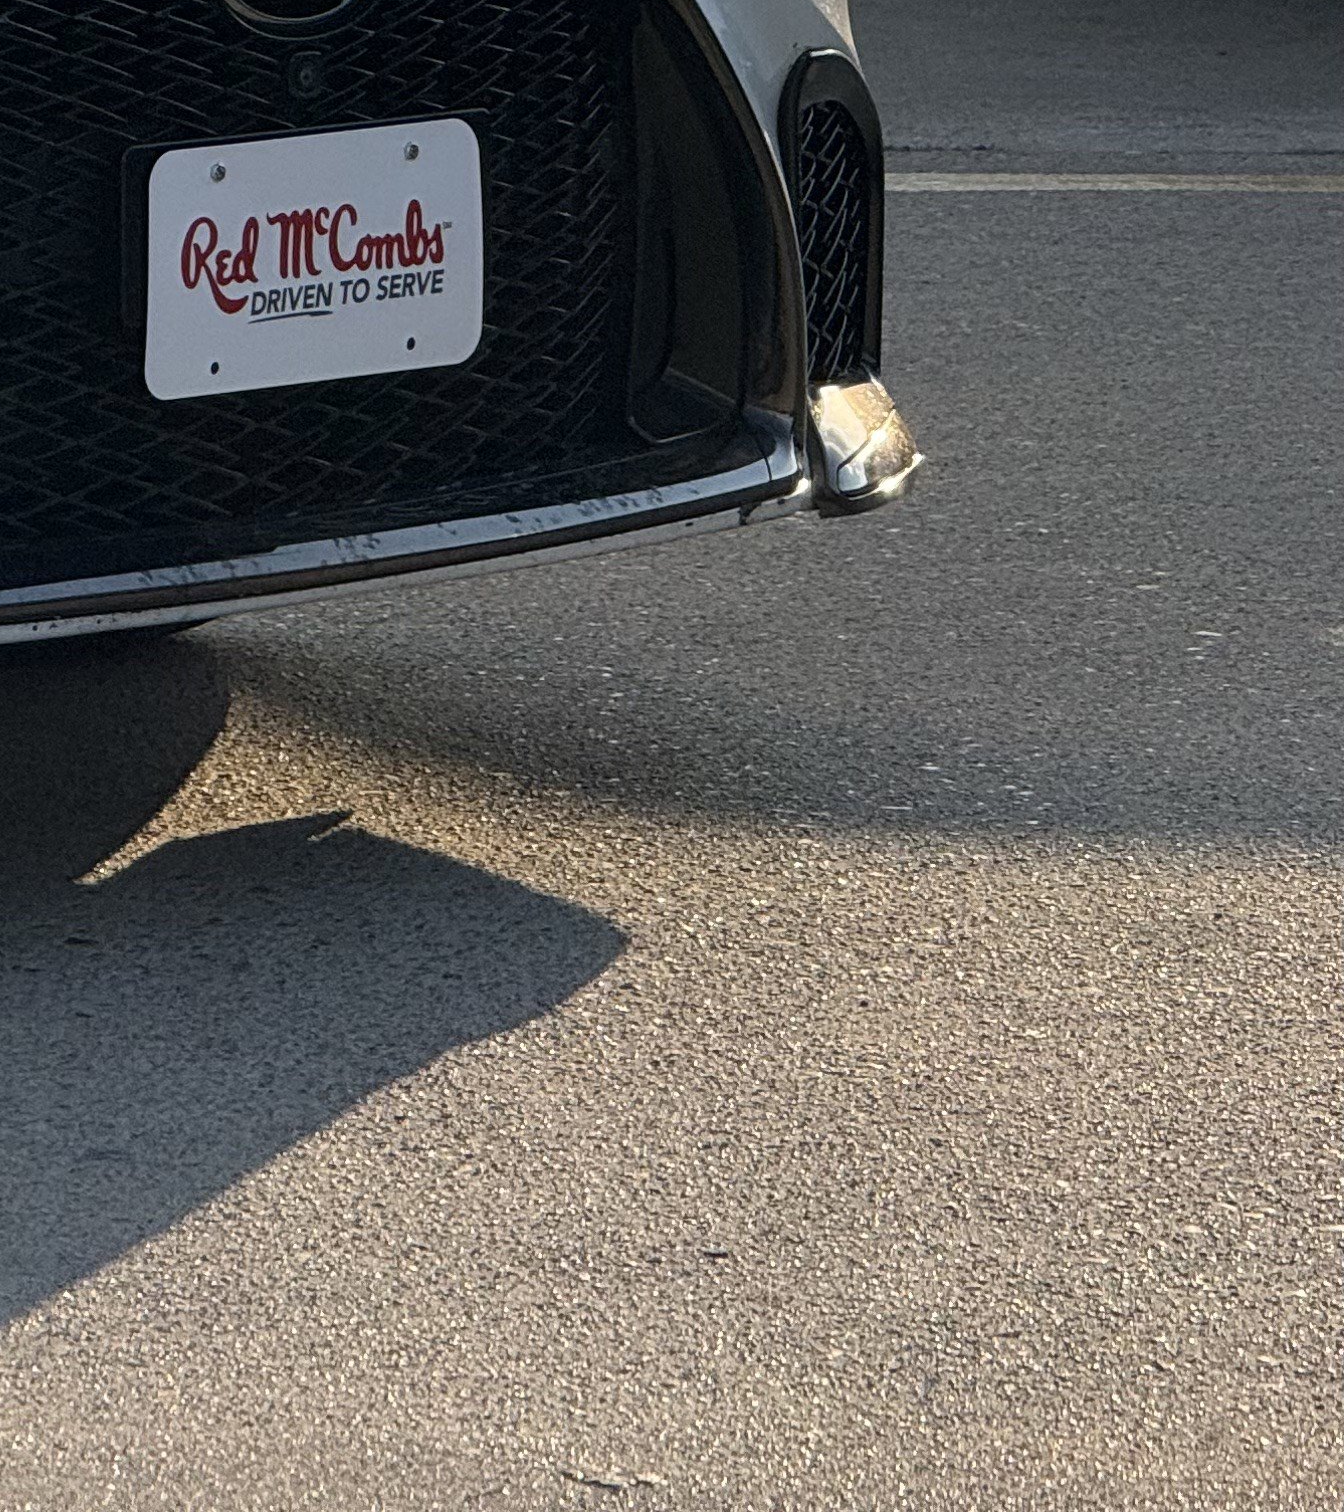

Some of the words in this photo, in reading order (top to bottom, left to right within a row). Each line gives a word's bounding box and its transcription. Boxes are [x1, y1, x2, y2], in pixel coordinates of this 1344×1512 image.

[180, 215, 260, 315] Red
[266, 198, 445, 280] McCombs
[249, 281, 334, 316] DRIVEN
[340, 278, 371, 305] TO
[376, 269, 445, 301] SERVE
